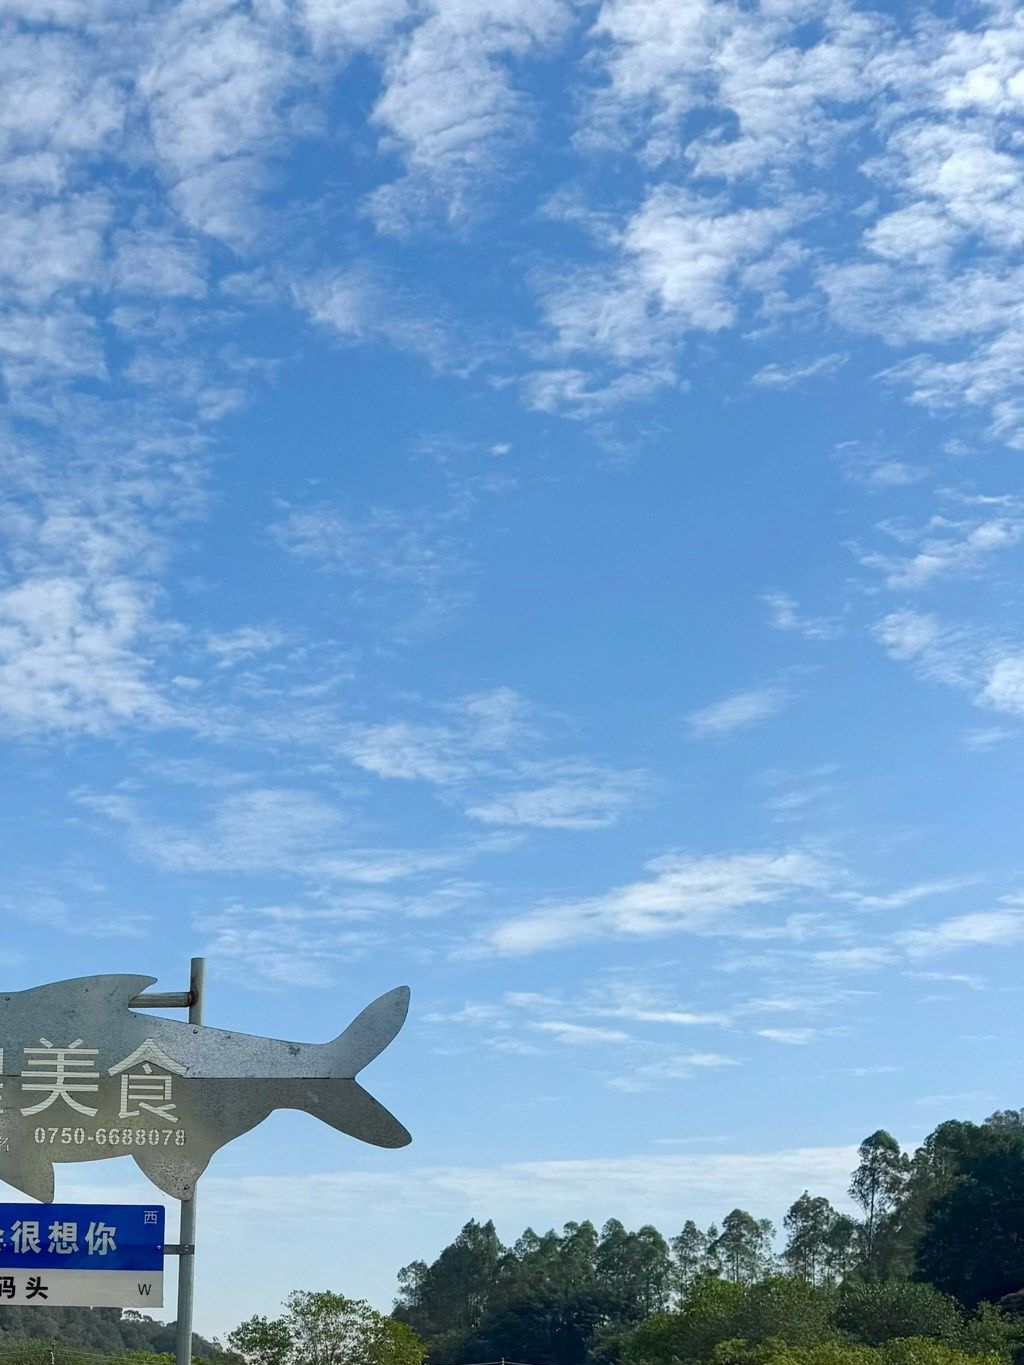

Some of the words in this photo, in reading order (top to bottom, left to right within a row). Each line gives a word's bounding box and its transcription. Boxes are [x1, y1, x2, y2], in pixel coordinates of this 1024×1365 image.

[34, 1126, 185, 1146] 0750-6688078
[143, 1210, 158, 1225] 西
[137, 1283, 153, 1296] W
